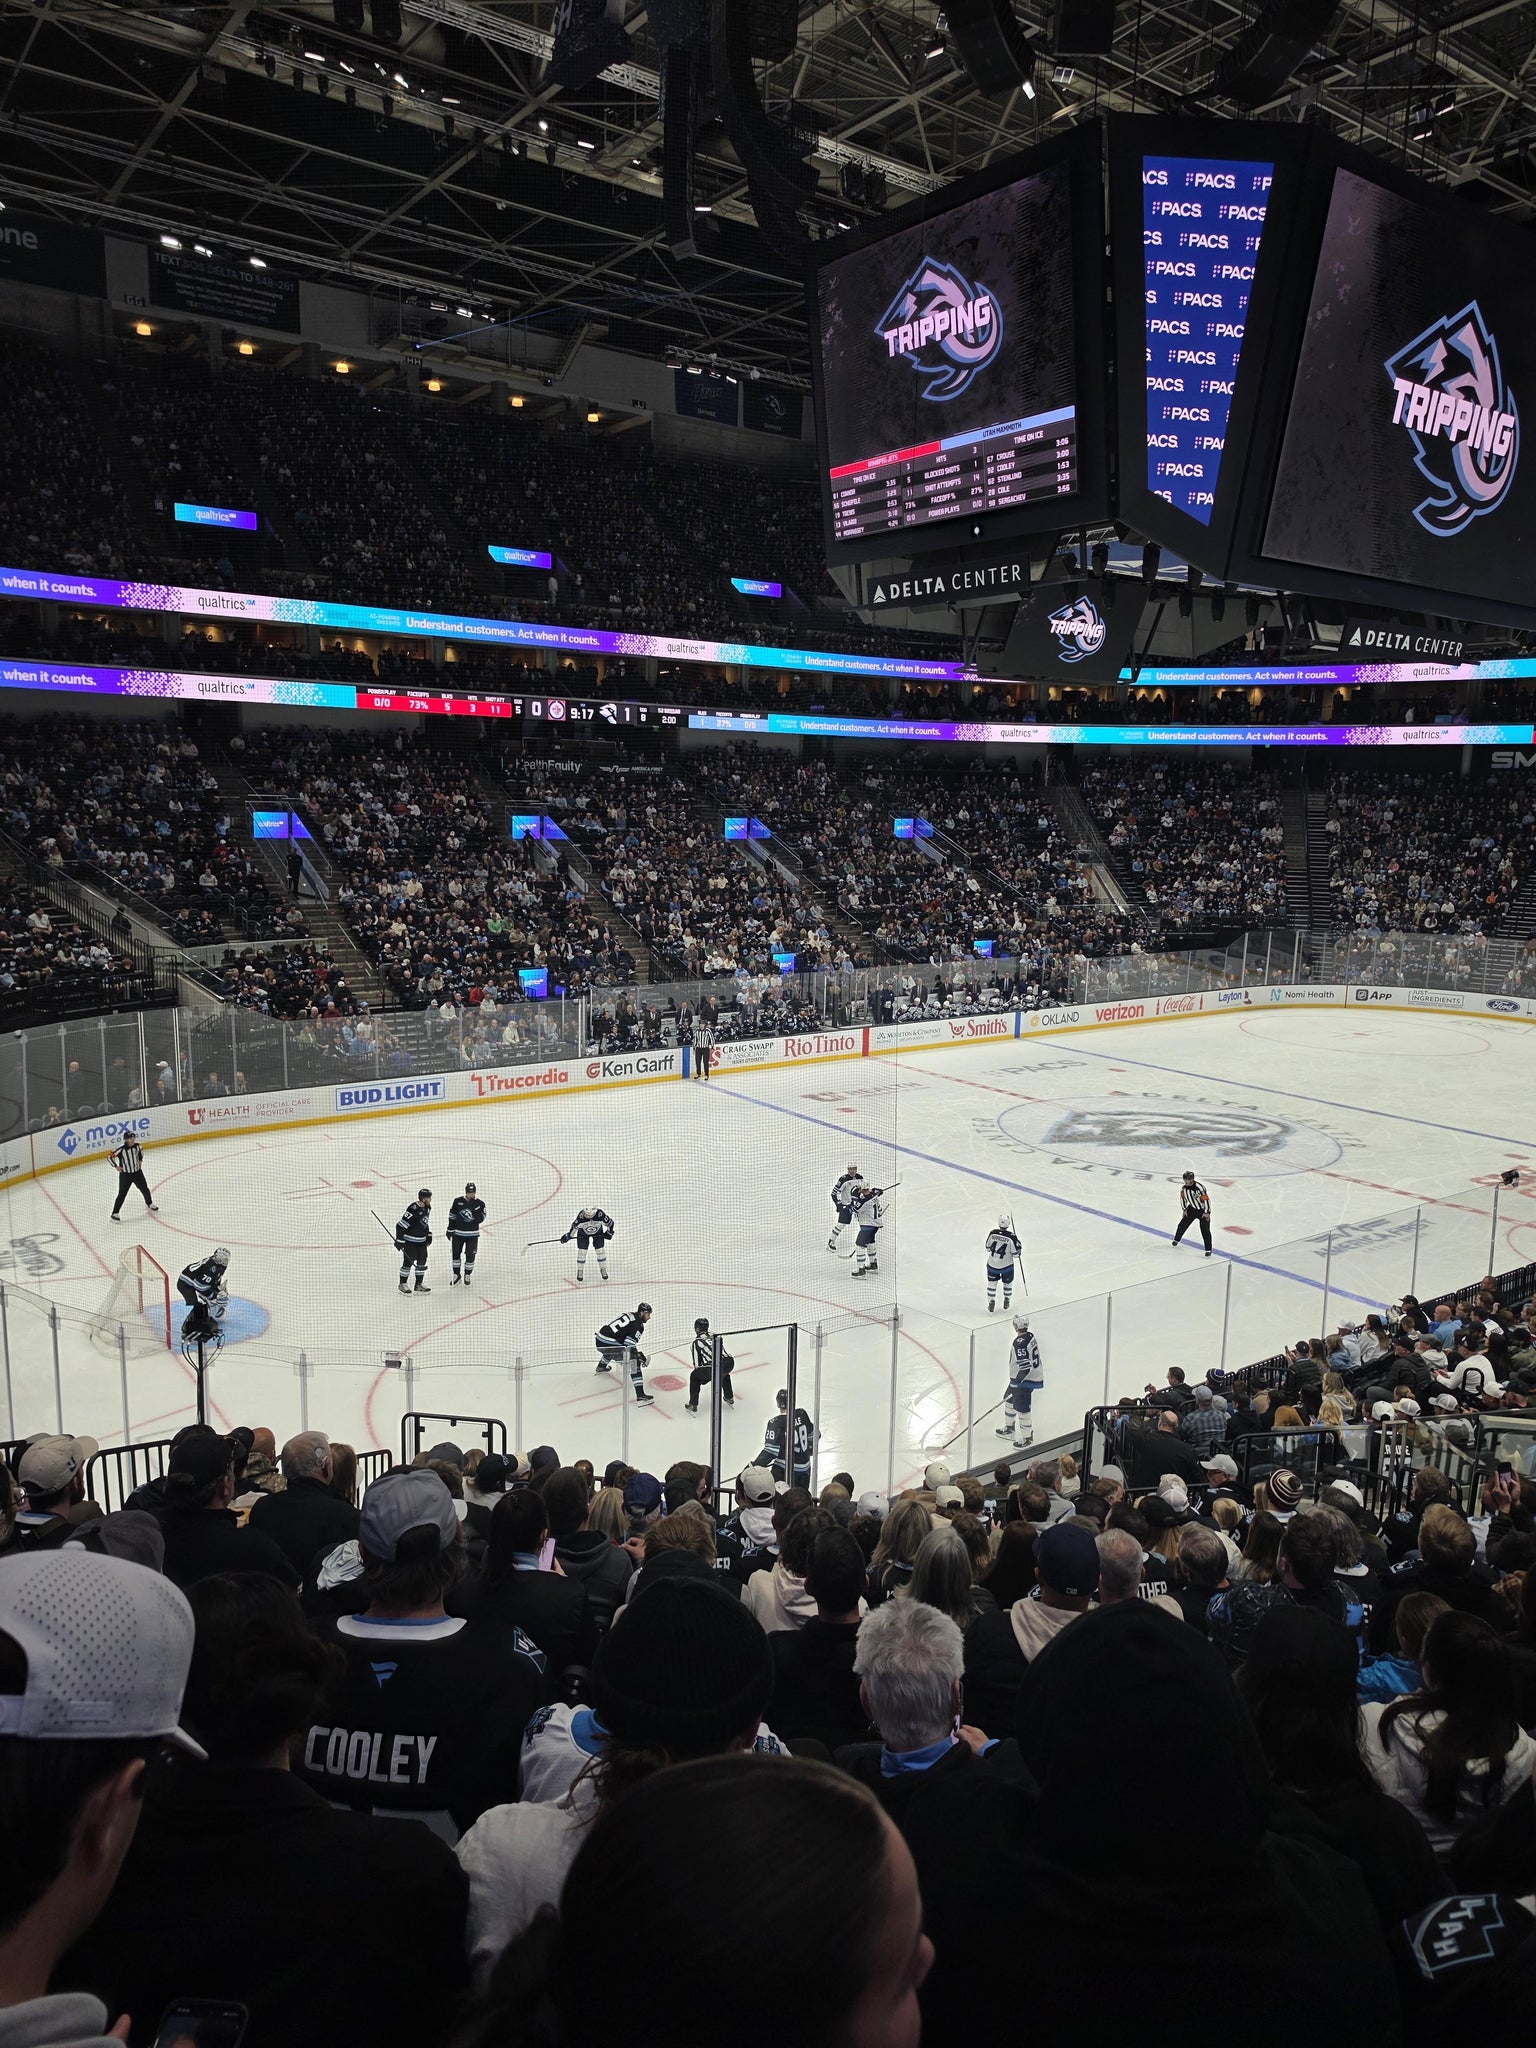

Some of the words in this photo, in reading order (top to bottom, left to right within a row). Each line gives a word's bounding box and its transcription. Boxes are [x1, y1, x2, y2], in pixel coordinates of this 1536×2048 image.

[1195, 173, 1236, 189] PACS
[1161, 202, 1202, 217] PACS
[1189, 233, 1229, 249] PACS
[155, 253, 180, 266] TEXT
[240, 272, 253, 281] TO
[1156, 261, 1196, 276] PACS
[1183, 292, 1222, 308] PACS
[884, 296, 991, 358] TRIPPING
[1151, 320, 1190, 334] PACS
[1177, 350, 1216, 365] PACS
[1146, 377, 1184, 391] PACS
[1172, 407, 1209, 421] PACS
[1393, 377, 1515, 456] TRIPPING
[983, 429, 995, 437] UTAH
[997, 422, 1021, 434] MAMMOTH
[1014, 435, 1026, 444] TIME
[1027, 433, 1034, 441] ON
[1035, 431, 1043, 439] ICE
[997, 451, 1015, 461] CROUSE
[1056, 438, 1069, 446] 3:06
[997, 462, 1015, 472] COOLEY
[1057, 449, 1069, 458] 3:00
[924, 468, 944, 479] BLOCKED
[945, 465, 960, 474] SHOTS
[1166, 463, 1203, 477] PACS
[925, 484, 936, 492] SHOT
[938, 478, 961, 490] ATTEMPTS
[998, 486, 1010, 494] COLE
[931, 494, 950, 504] FACEOFF
[971, 487, 982, 495] 27%
[929, 508, 944, 517] POWER
[945, 505, 960, 514] PLAYS
[3, 576, 37, 590] when
[40, 579, 49, 591] it
[51, 584, 96, 596] counts.
[890, 576, 945, 599] DELTA
[952, 564, 1021, 589] CENTER
[406, 617, 462, 632] Understand
[465, 626, 516, 638] customers.
[519, 629, 533, 639] Act
[536, 631, 558, 641] when
[560, 633, 567, 642] it
[569, 635, 600, 645] counts.
[1051, 620, 1103, 640] TRIPPING
[1365, 630, 1410, 650] DELTA
[1415, 637, 1462, 657] CENTER
[805, 656, 843, 667] Understand
[845, 661, 881, 671] customers.
[883, 663, 894, 672] Act
[896, 664, 912, 673] when
[914, 665, 919, 673] it
[921, 666, 947, 675] counts.
[4, 669, 37, 681] when
[40, 671, 49, 682] it
[52, 674, 96, 685] counts.
[1156, 672, 1204, 680] Understand
[1206, 672, 1252, 680] customers.
[1254, 672, 1270, 680] Act
[1272, 671, 1295, 679] when
[1297, 671, 1302, 679] it
[1305, 671, 1337, 679] counts.
[374, 698, 390, 707] 0/0
[409, 700, 428, 710] 73%
[445, 703, 450, 711] 5
[470, 704, 475, 712] 3
[532, 702, 541, 716] 0
[491, 706, 499, 714] 11
[516, 706, 521, 714] 5
[571, 708, 594, 720] 9:17
[625, 708, 630, 721] 1
[662, 716, 676, 724] 2:00
[801, 722, 839, 730] Understand
[841, 724, 876, 732] customers.
[1148, 732, 1196, 740] Understand
[1246, 732, 1261, 740] Act
[1263, 732, 1286, 740] when
[1288, 732, 1294, 740] it
[1296, 732, 1328, 740] counts.
[1491, 752, 1536, 768] SM
[1218, 992, 1241, 1003] Layton
[1308, 990, 1334, 998] Health
[1412, 996, 1460, 1004] INGREDIENTS
[1096, 1004, 1144, 1021] verizon
[1492, 1002, 1513, 1011] Ford
[1042, 1012, 1079, 1026] OKLAND
[967, 1017, 1007, 1036] Smith's
[723, 1045, 746, 1054] CRAIG
[749, 1042, 773, 1051] SWAPP
[602, 1060, 632, 1077] Ken
[636, 1055, 674, 1074] Garff
[1005, 1059, 1087, 1075] PACS
[486, 1069, 568, 1092] Trucordia
[341, 1086, 382, 1106] BUD
[385, 1082, 441, 1102] LIGHT
[256, 1102, 288, 1110] OFFICIAL
[292, 1098, 311, 1106] CARE
[210, 1106, 250, 1118] HEALTH
[256, 1108, 294, 1117] PROVIDER
[86, 1118, 150, 1141] moxie
[87, 1141, 106, 1149] PEST
[990, 1241, 1007, 1259] 44
[201, 1275, 212, 1283] 70
[609, 1314, 630, 1334] 2
[1030, 1346, 1040, 1368] 5
[766, 1430, 775, 1440] 28
[304, 1725, 437, 1784] COOLEY
